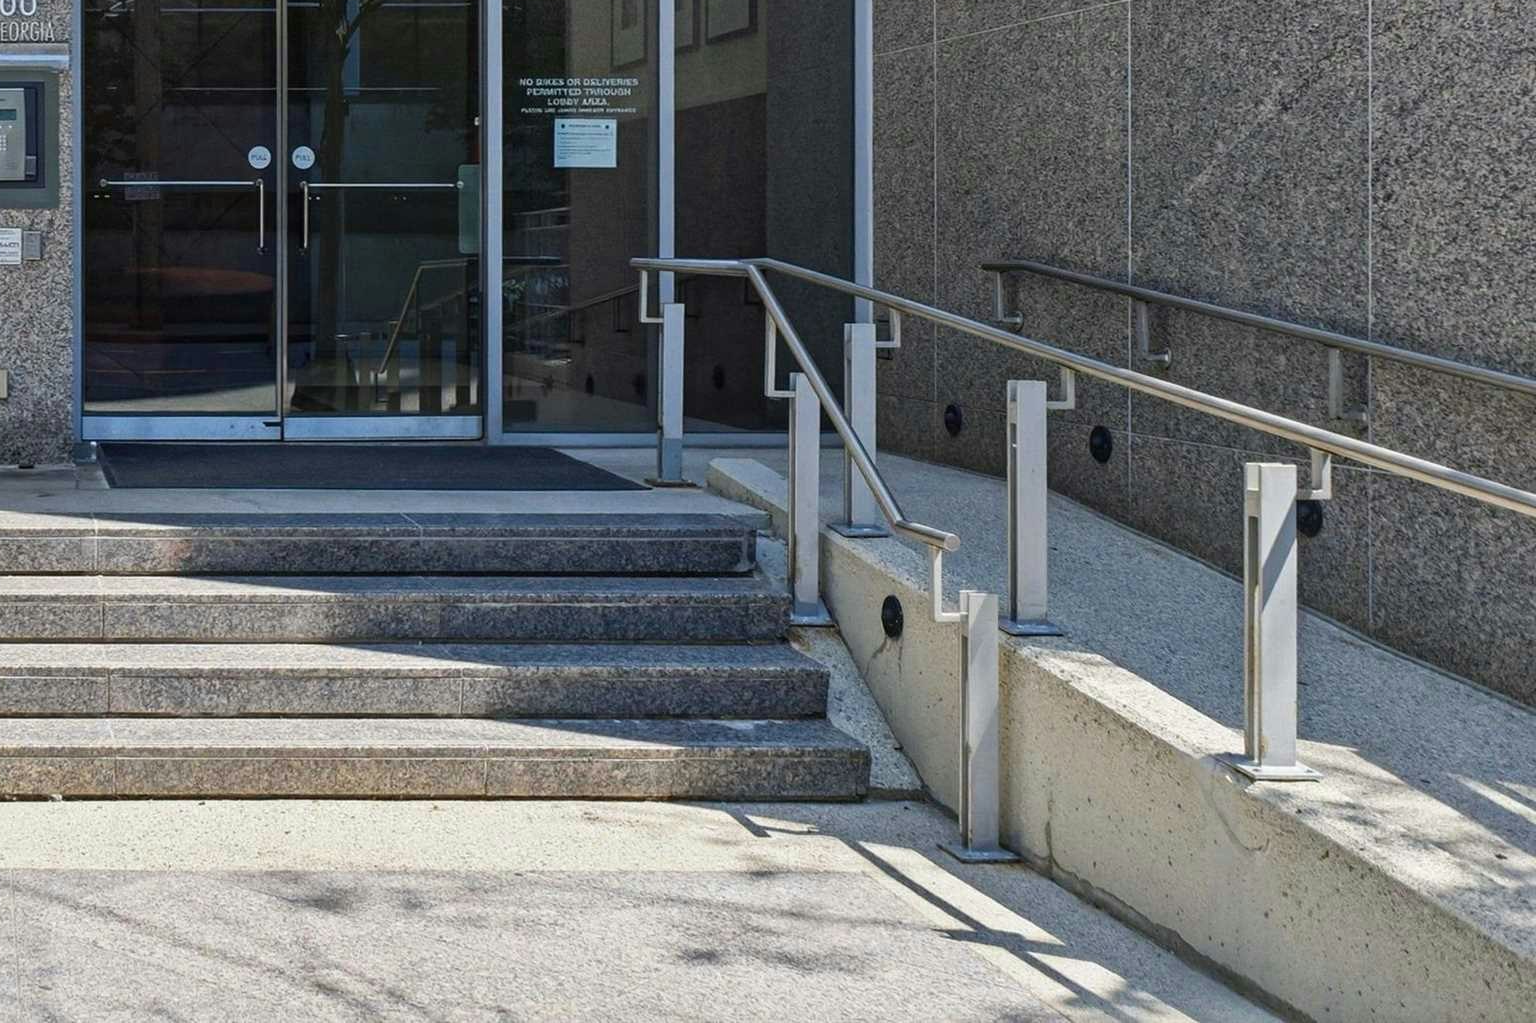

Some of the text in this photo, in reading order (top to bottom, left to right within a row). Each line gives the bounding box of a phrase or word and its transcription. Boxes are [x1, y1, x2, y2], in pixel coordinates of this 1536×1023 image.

[519, 78, 534, 86] NO
[566, 78, 581, 86] OR
[583, 78, 639, 86] DELIVERIES
[526, 88, 631, 96] PERMITTED THROUGH
[547, 98, 578, 106] LOBBY
